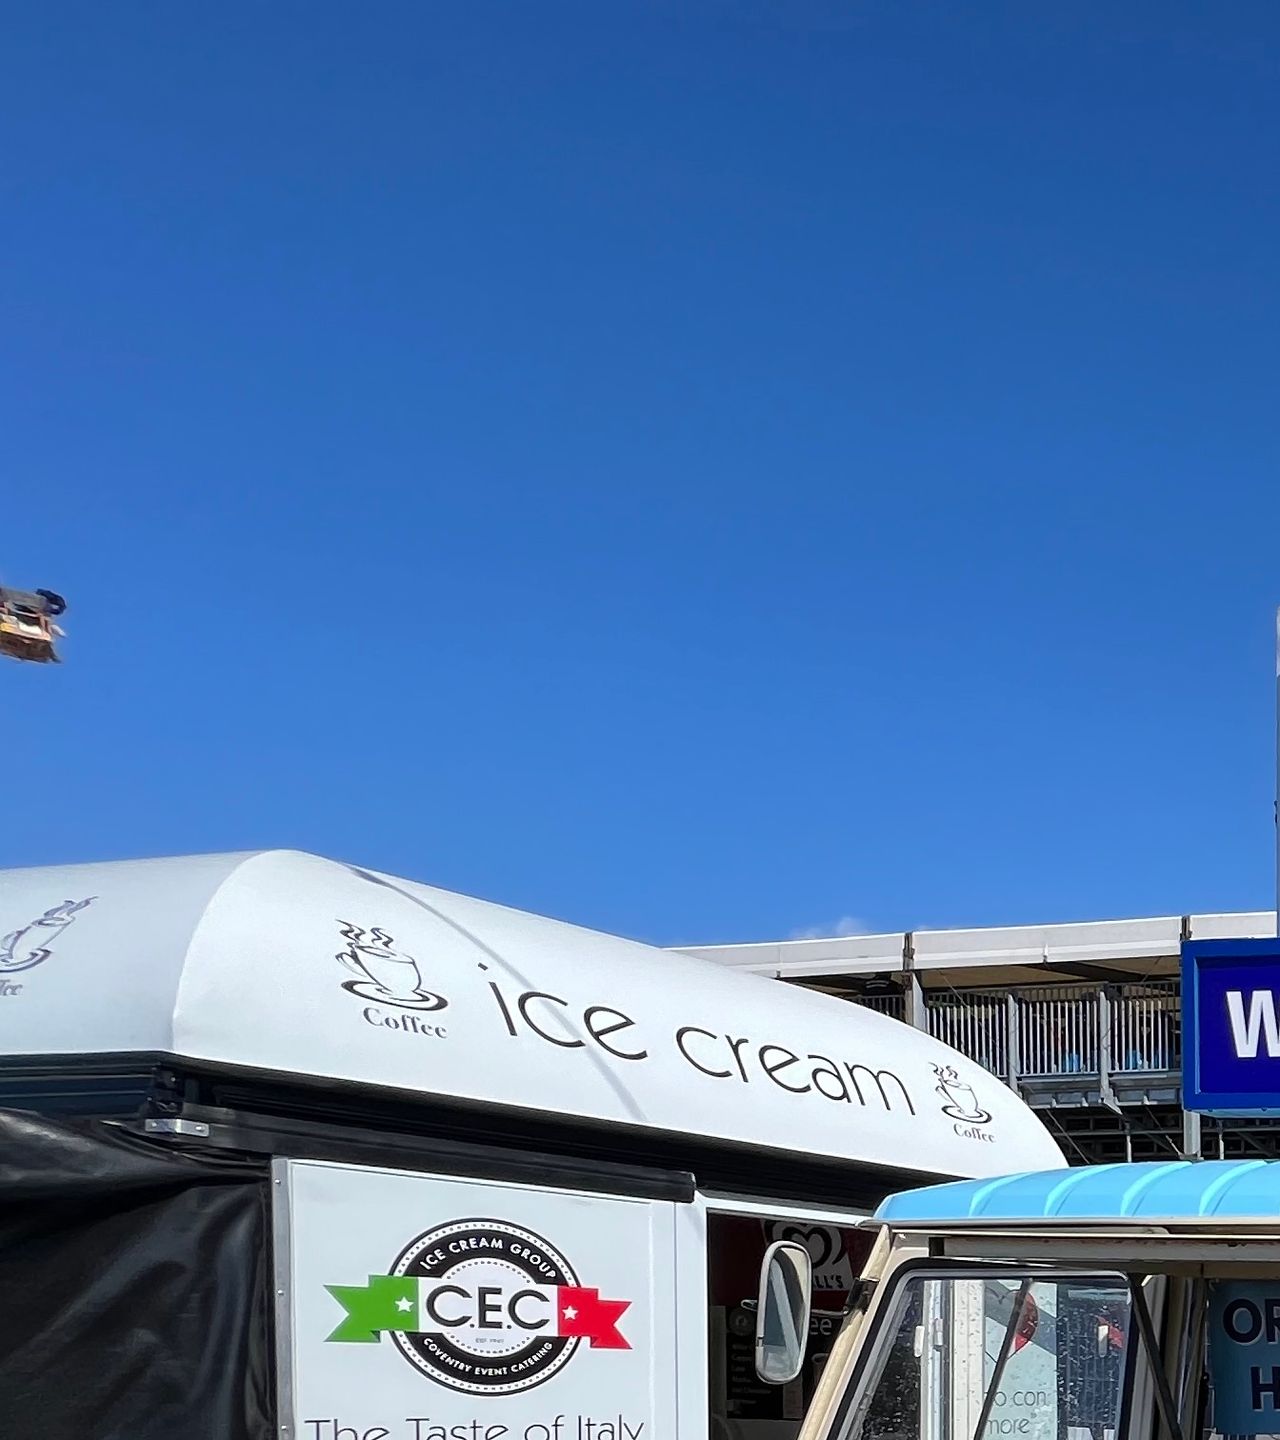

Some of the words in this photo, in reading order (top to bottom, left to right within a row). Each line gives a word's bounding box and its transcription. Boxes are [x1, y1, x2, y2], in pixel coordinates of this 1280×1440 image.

[363, 1007, 448, 1039] Coffee
[477, 962, 648, 1060] ice
[675, 1025, 916, 1116] cream
[952, 1122, 996, 1144] Coffee
[419, 1248, 447, 1270] ICE
[448, 1237, 503, 1253] CREAM
[510, 1243, 557, 1279] GROUP
[423, 1338, 472, 1373] COVENTRY
[474, 1366, 508, 1376] EVENT
[510, 1341, 553, 1373] CATERING
